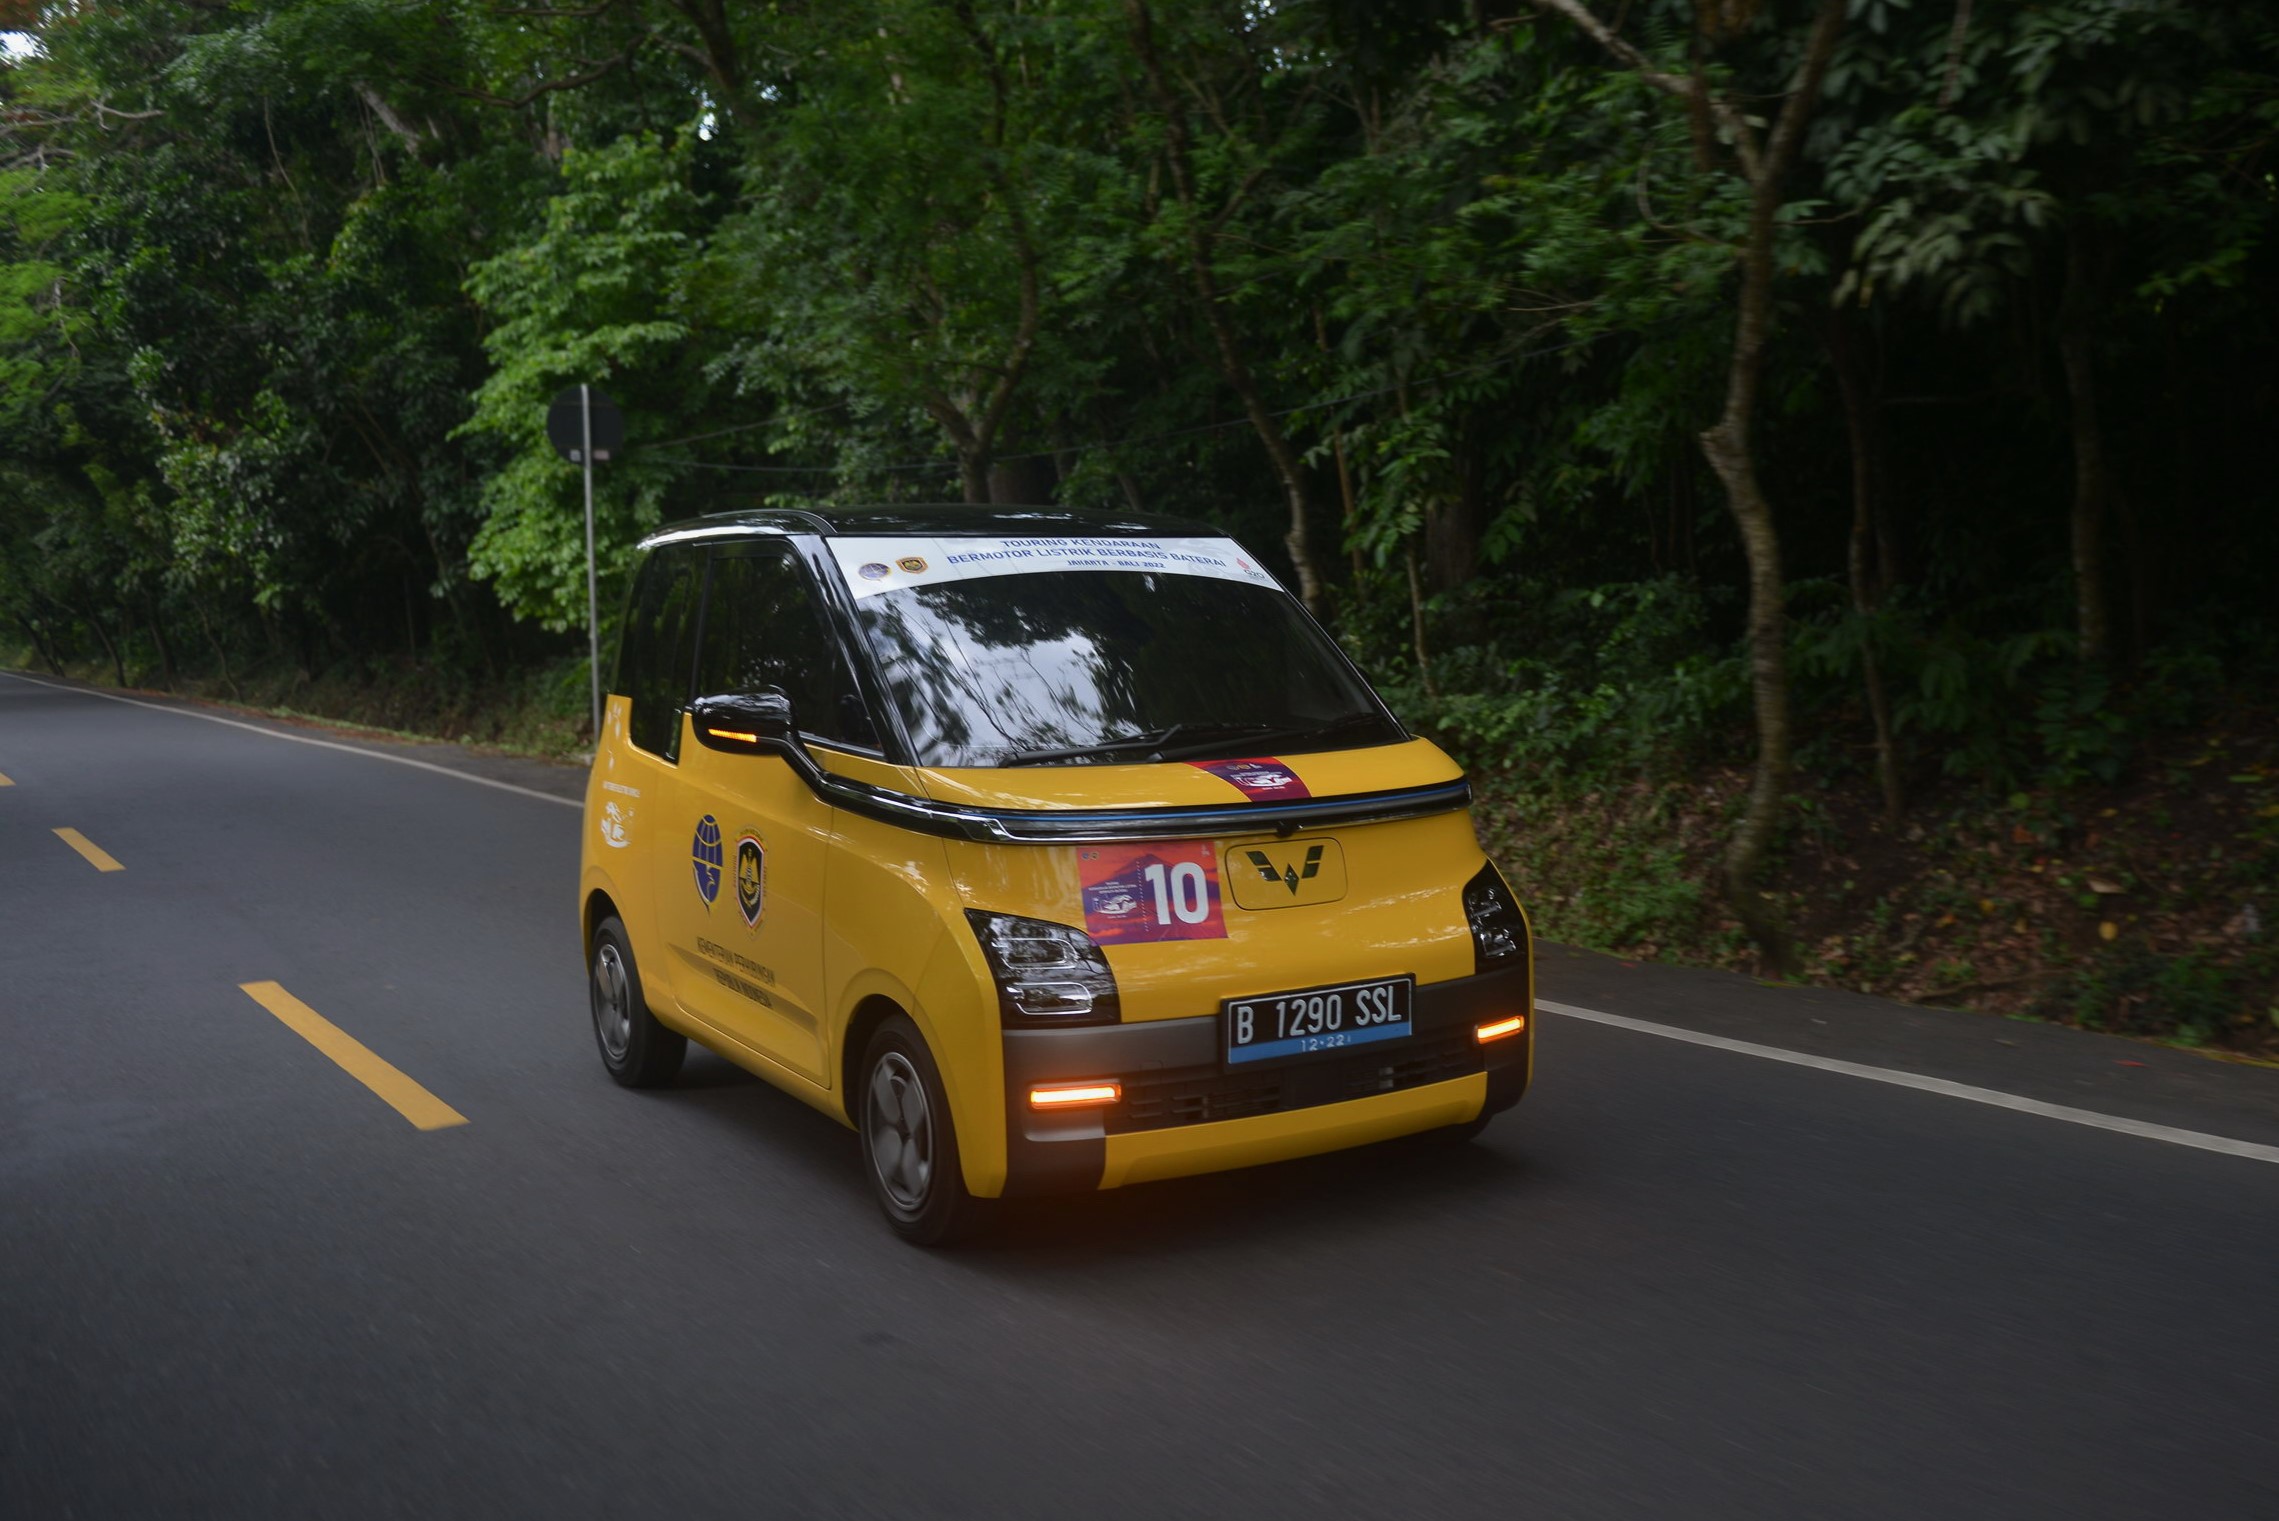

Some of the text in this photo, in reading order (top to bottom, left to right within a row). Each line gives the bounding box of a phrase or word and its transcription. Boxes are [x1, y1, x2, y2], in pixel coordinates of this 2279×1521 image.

[947, 548, 1226, 567] BERMOTOR LISTRIK BERBASIS BATERAI
[1001, 538, 1161, 550] TOURING KENDARAAN
[1144, 861, 1210, 925] 10
[1237, 985, 1402, 1044] B 1290 SSL
